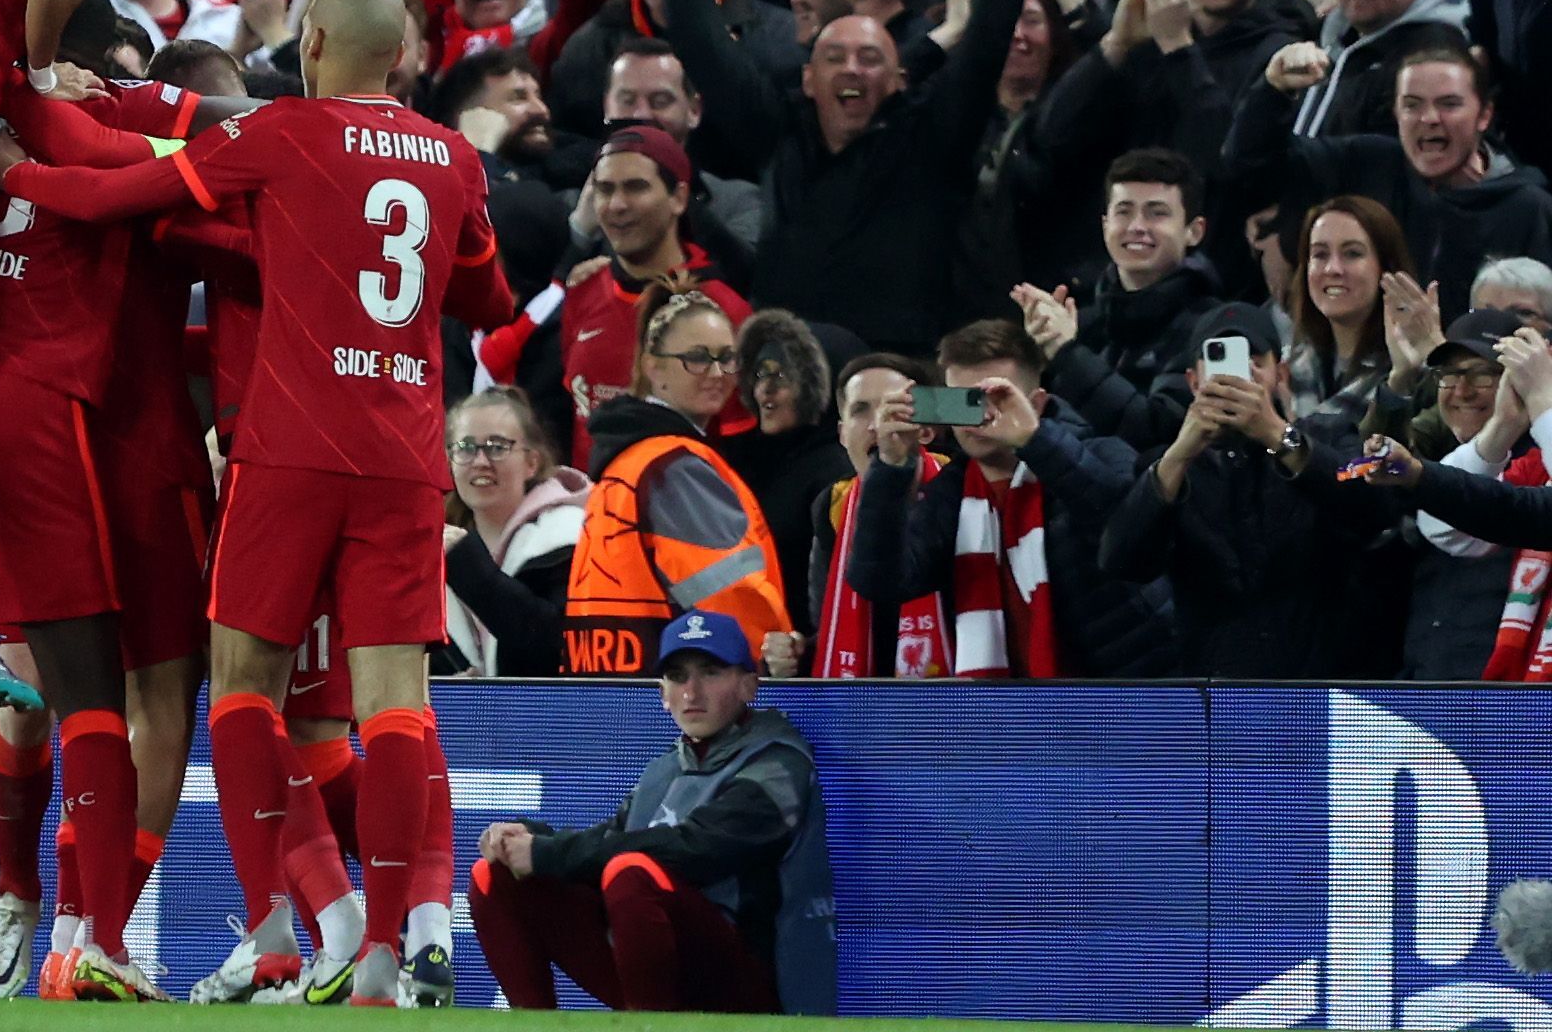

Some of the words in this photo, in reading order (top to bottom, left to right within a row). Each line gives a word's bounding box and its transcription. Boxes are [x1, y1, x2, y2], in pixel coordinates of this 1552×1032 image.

[344, 126, 450, 167] FABINHO
[359, 178, 429, 327] 3
[333, 346, 382, 377] SIDE
[393, 353, 427, 386] SIDE
[65, 791, 96, 813] FC
